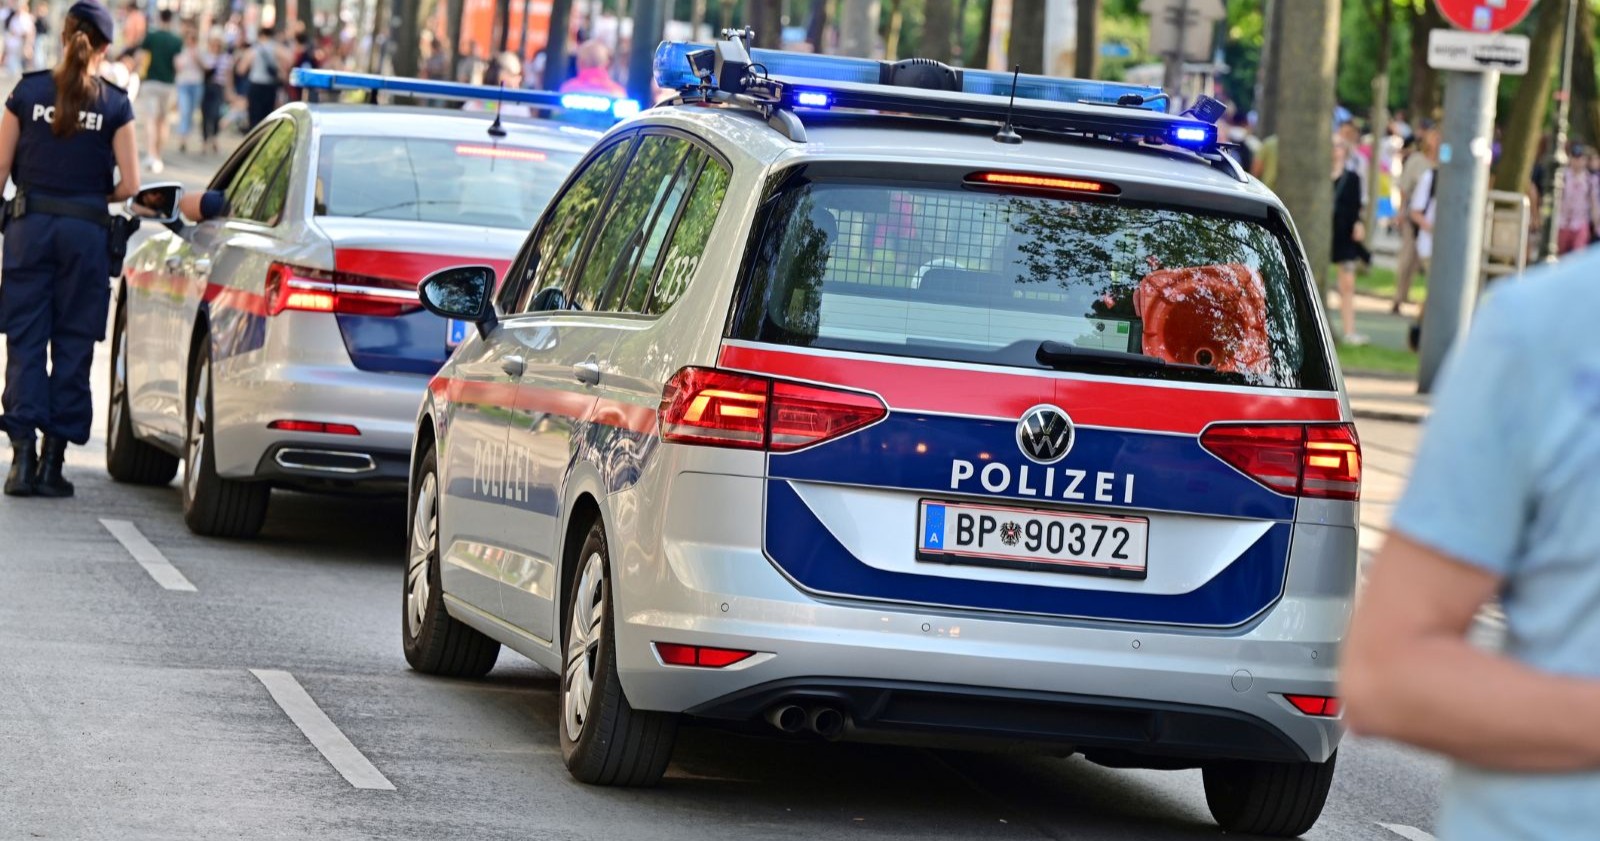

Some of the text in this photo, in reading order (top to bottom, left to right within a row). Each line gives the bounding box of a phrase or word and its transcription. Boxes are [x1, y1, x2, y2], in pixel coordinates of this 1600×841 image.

[32, 103, 103, 131] POZEI
[473, 440, 530, 503] POLIZEI
[950, 459, 1135, 503] POLIZEI
[929, 532, 939, 544] A
[956, 513, 1130, 560] BP 90372
